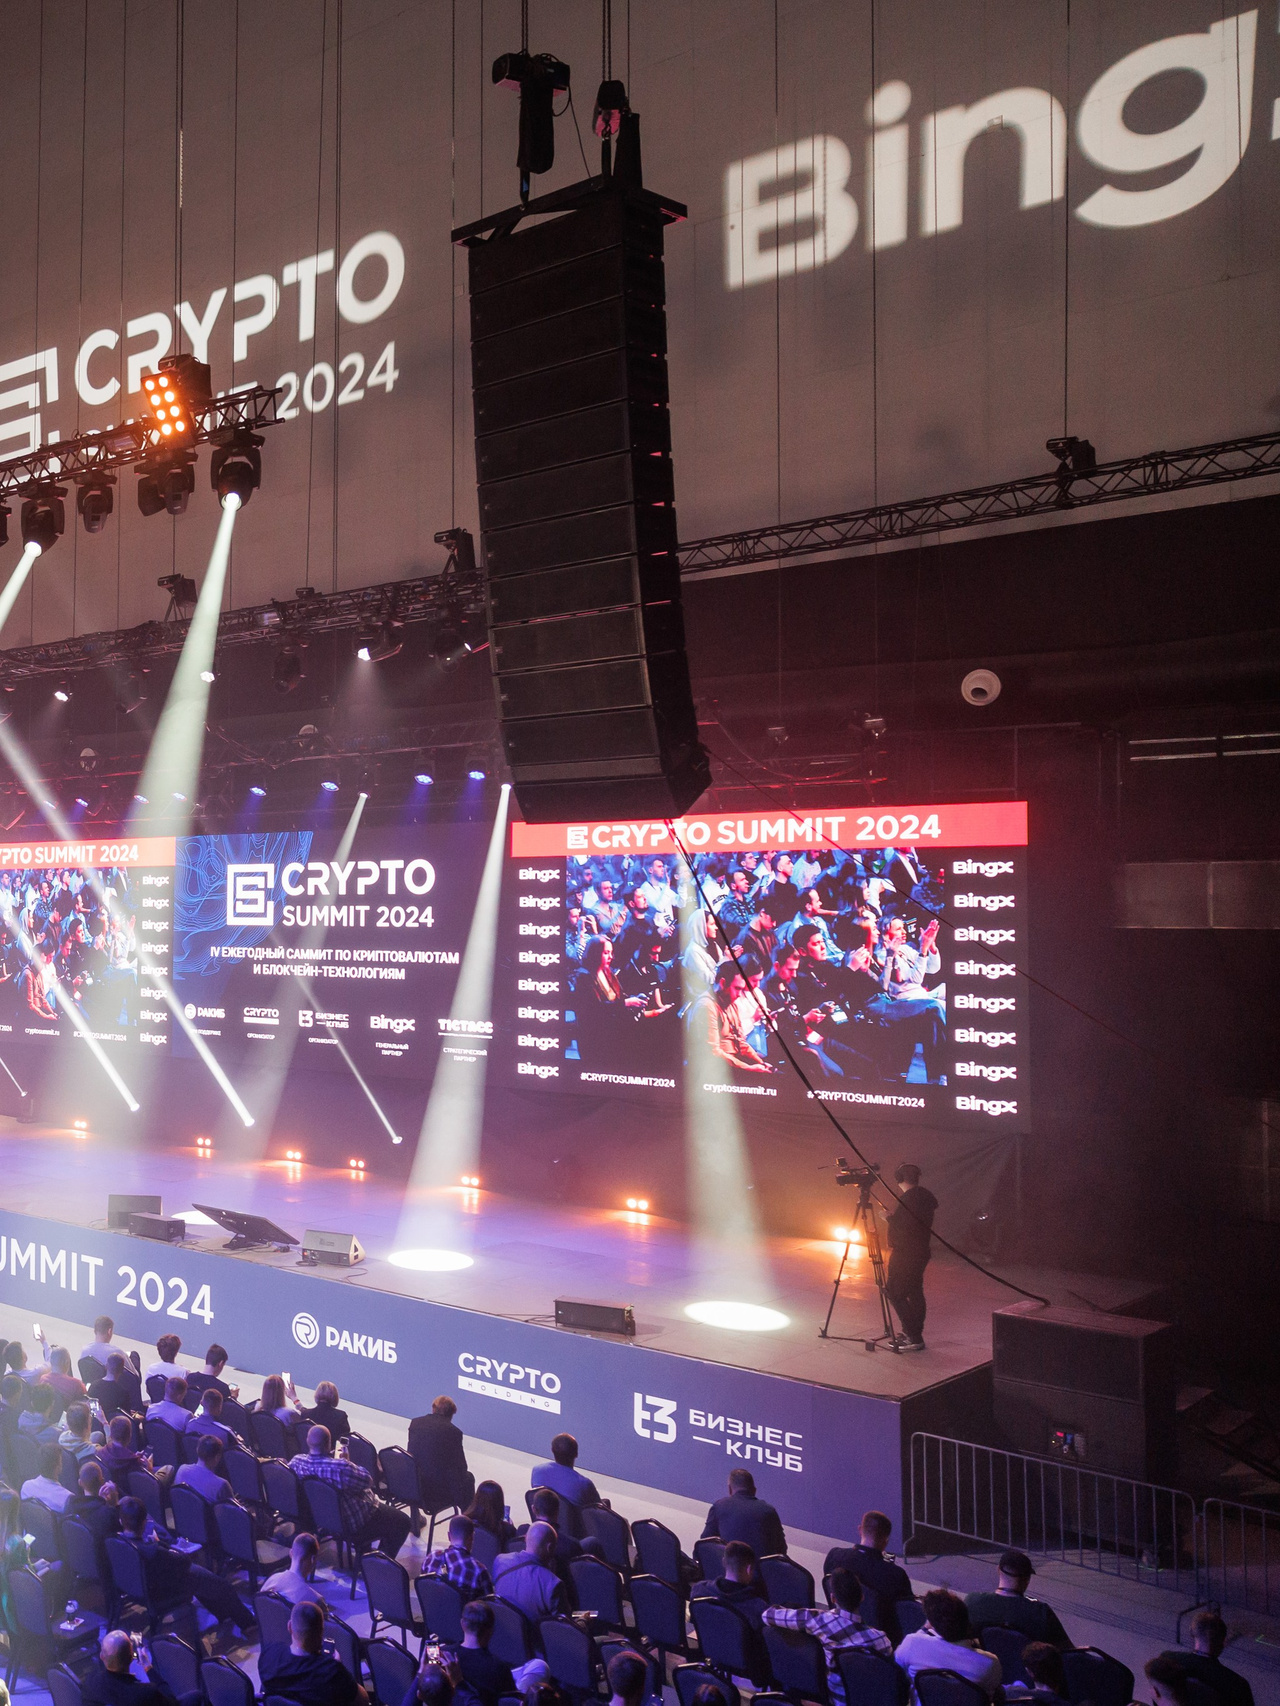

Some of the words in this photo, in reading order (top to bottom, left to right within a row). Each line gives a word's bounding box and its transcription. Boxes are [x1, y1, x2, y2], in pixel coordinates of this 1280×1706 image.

[724, 0, 1280, 291] Bing
[75, 230, 405, 405] CRYPTO
[275, 340, 399, 421] 2024
[592, 822, 711, 848] CRYPTO
[717, 817, 845, 845] SUMMIT
[856, 814, 941, 841] 2024
[34, 845, 96, 864] SUMMIT
[100, 845, 139, 861] 2024
[281, 858, 436, 896] CRYPTO
[282, 905, 370, 927] SUMMIT
[376, 906, 434, 927] 2024
[210, 946, 220, 957] IV
[221, 946, 284, 960] ЕЖЕГОДНЫЙ
[286, 948, 333, 960] САММИТ
[335, 949, 351, 961] ПО
[353, 950, 459, 964] КРИПТОВАЛЮТАМ
[253, 964, 261, 974] И
[263, 963, 405, 980] БЛОКЧЕЙН-ТЕХНОЛОГИЯМ
[244, 1007, 279, 1018] CRYPTO
[315, 1012, 349, 1021] БИЗНЕС
[580, 1072, 676, 1088] #CRYPTOSUMMIT2024
[703, 1081, 777, 1097] cryptosummit.ru
[806, 1090, 926, 1108] #CRYPTOSUMMIT2024
[116, 1265, 215, 1325] 2024
[325, 1325, 397, 1364] РАКИБ
[458, 1352, 561, 1394] CRYPTO
[467, 1381, 550, 1408] HOLDING
[689, 1408, 803, 1451] БИЗНЕС
